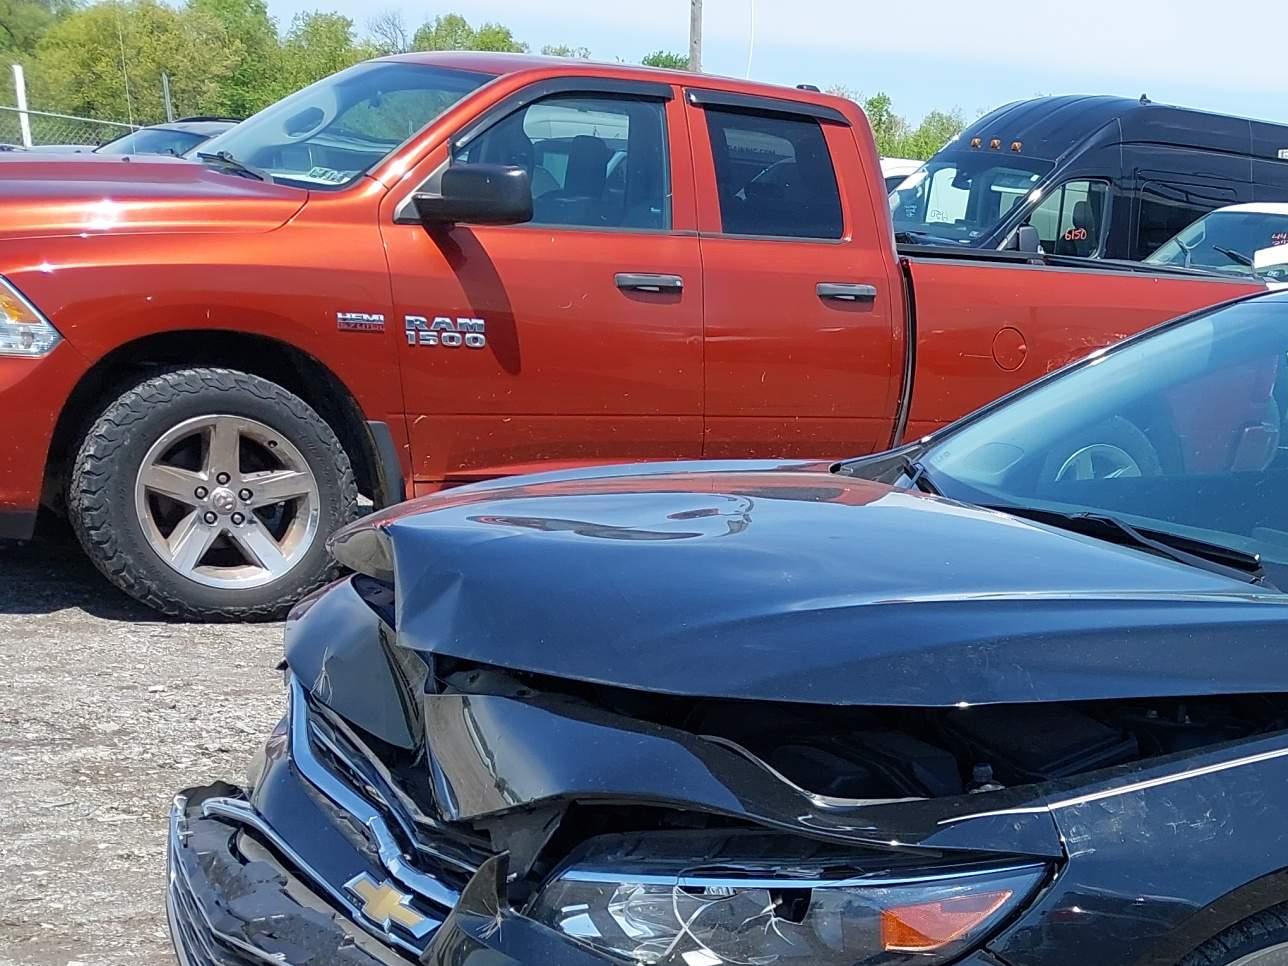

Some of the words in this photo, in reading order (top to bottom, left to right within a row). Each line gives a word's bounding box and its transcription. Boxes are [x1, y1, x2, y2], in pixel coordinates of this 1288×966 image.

[1064, 227, 1087, 241] 6150
[336, 312, 385, 323] HEMI
[405, 315, 485, 332] RAM
[406, 331, 486, 347] 1500
